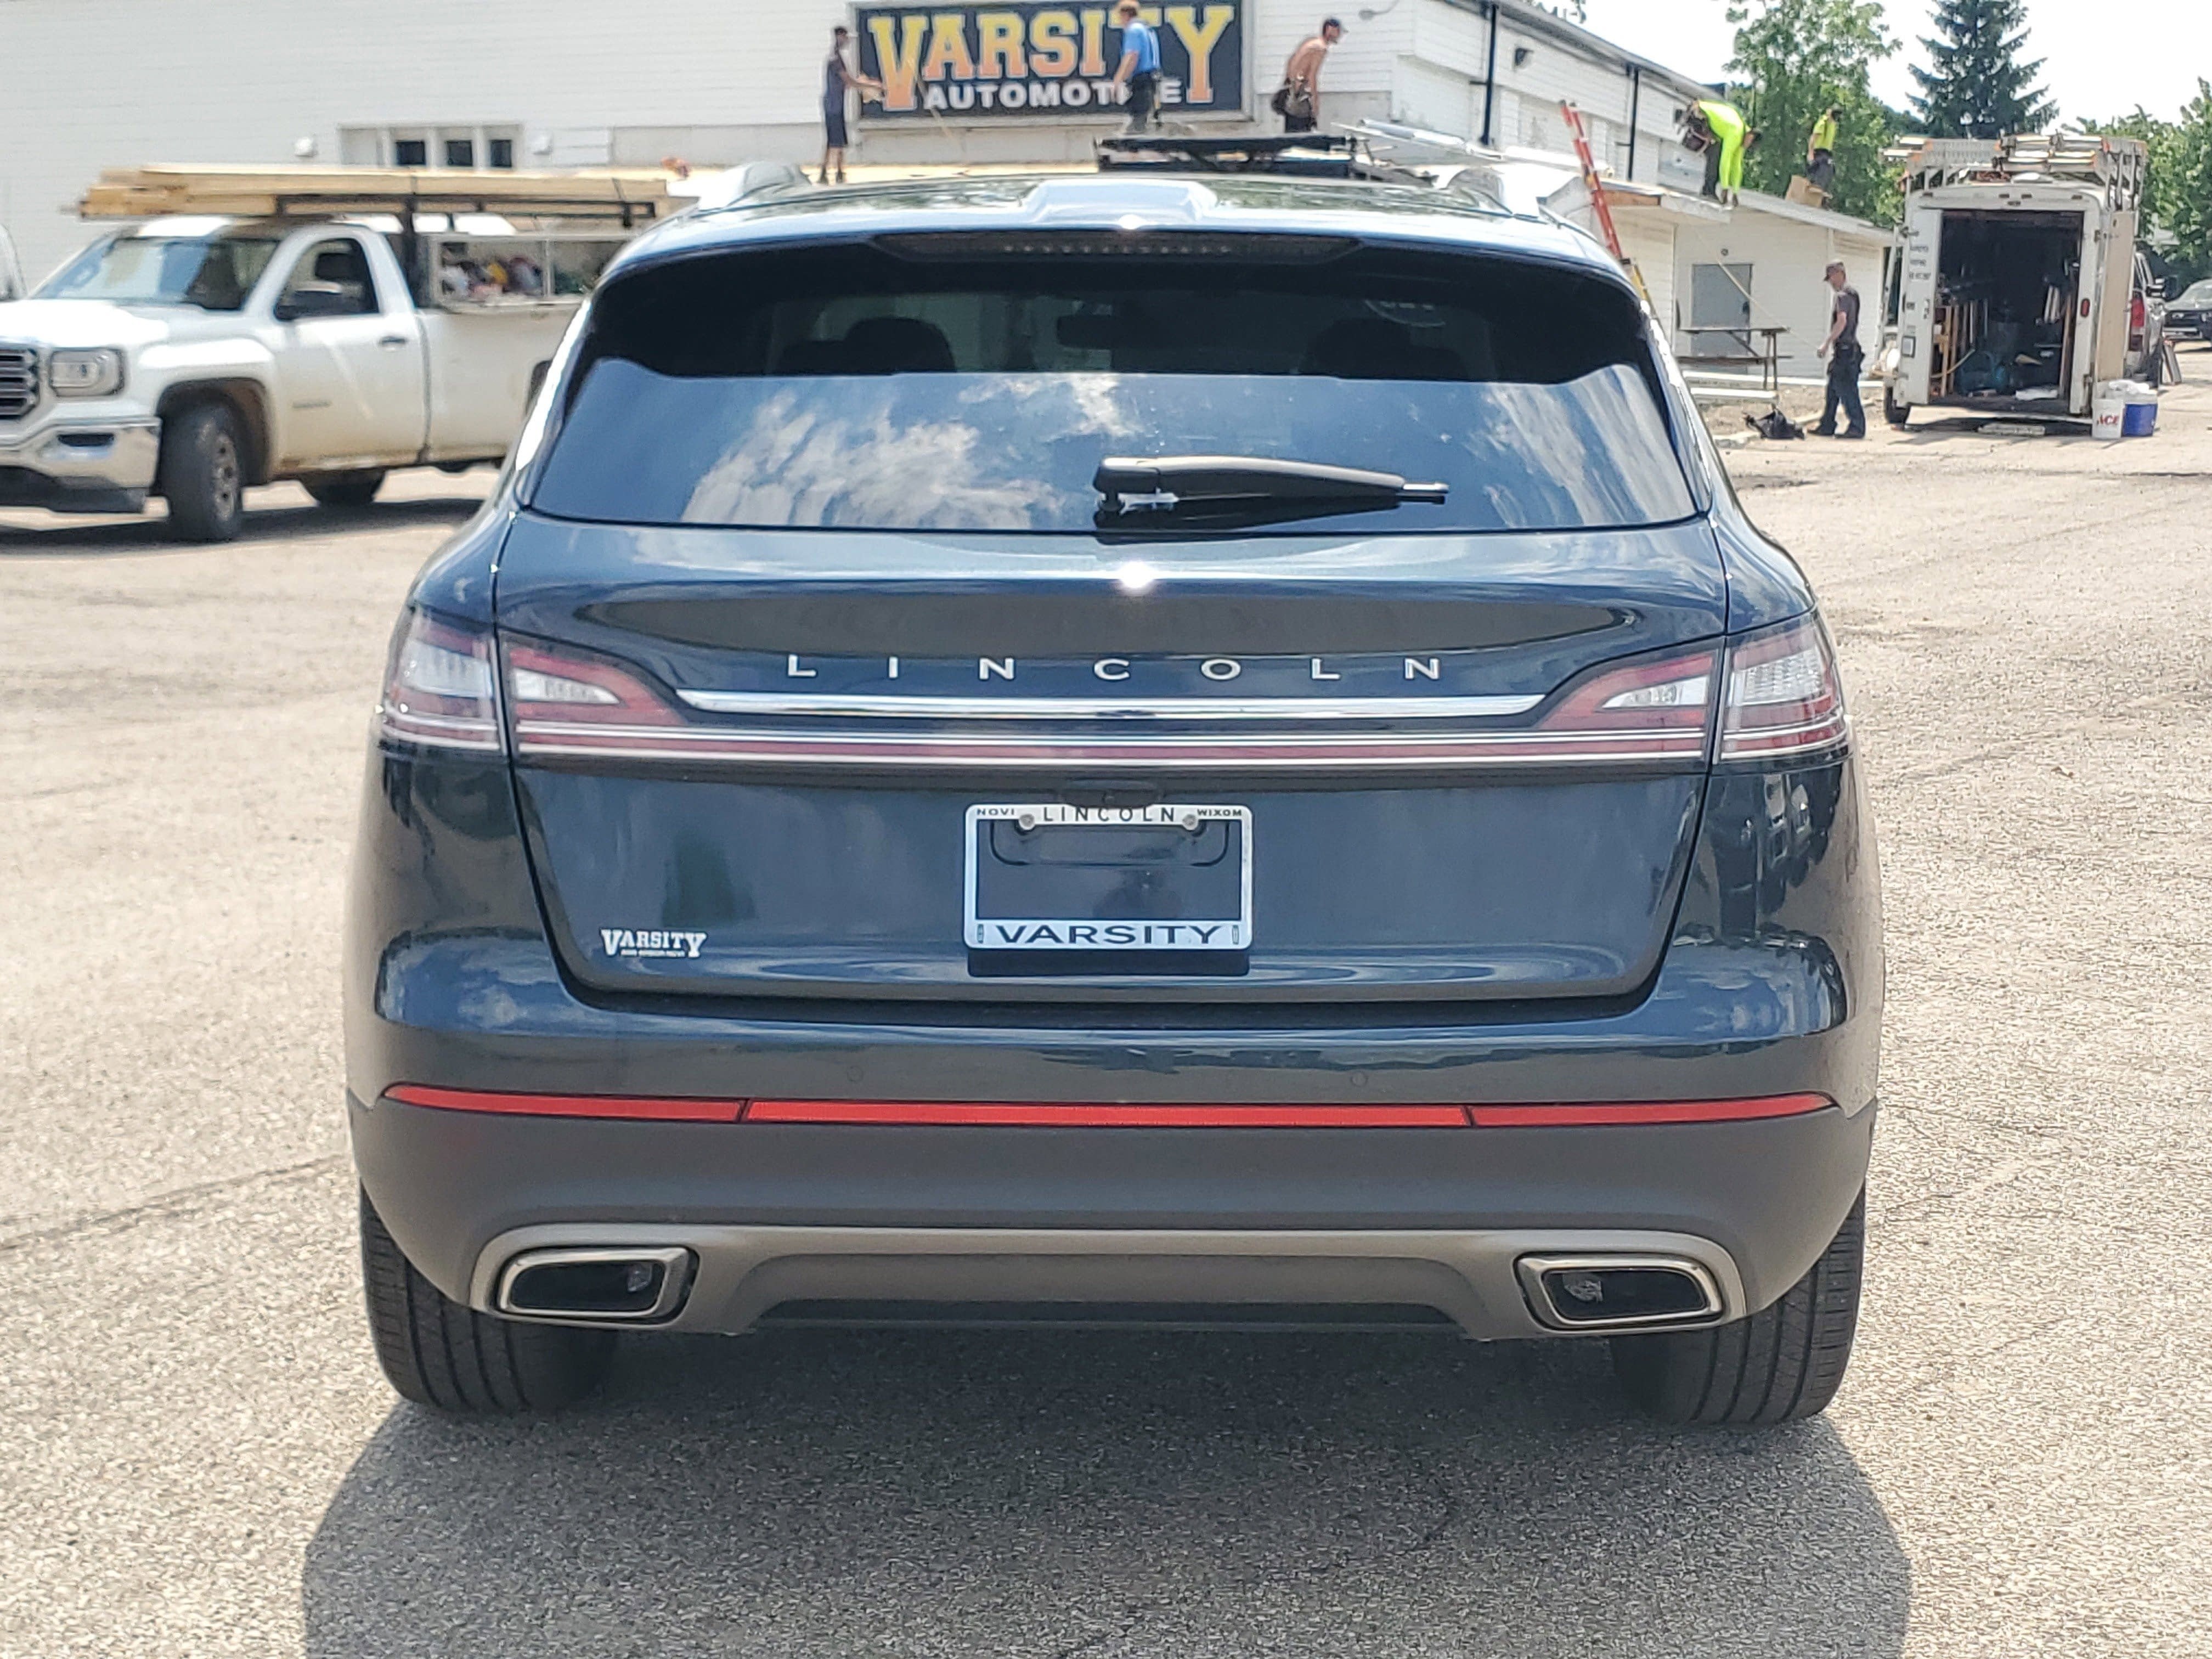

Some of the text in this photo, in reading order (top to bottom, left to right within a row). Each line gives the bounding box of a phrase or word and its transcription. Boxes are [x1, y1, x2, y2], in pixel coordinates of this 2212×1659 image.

[923, 80, 1182, 109] AUTOMOTIE
[787, 654, 1441, 681] LINCOLN
[1043, 806, 1175, 822] LINCOLN
[600, 929, 707, 958] VARSITY
[996, 925, 1221, 945] VARSITY
